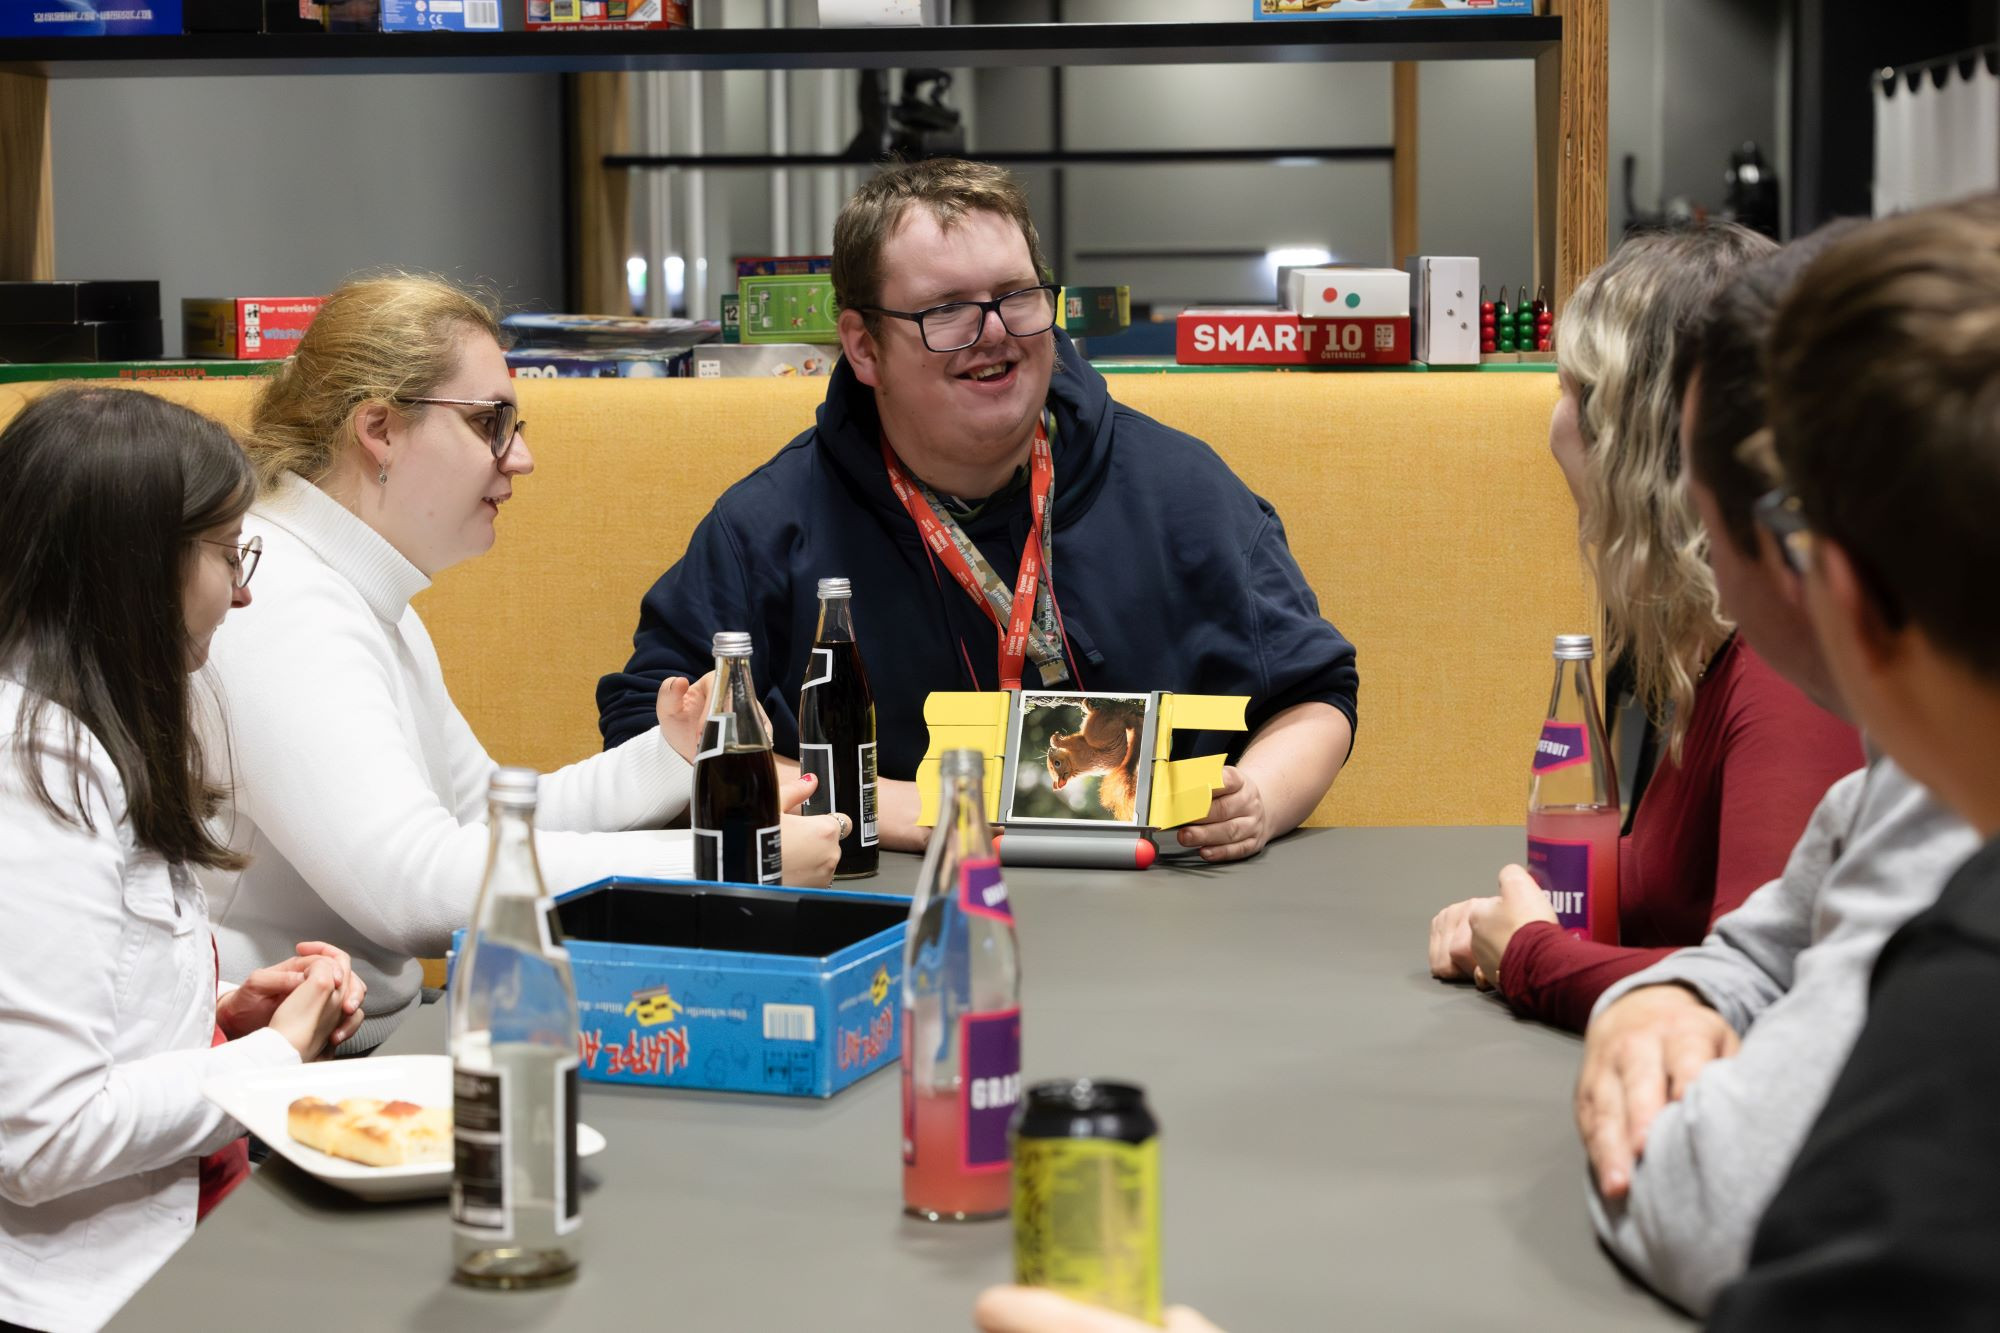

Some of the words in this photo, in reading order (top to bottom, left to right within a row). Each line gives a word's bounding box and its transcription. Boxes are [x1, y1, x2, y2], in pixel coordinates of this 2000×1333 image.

[725, 306, 738, 321] 12
[1194, 324, 1317, 352] SMART
[1325, 324, 1362, 351] 10
[1321, 351, 1366, 359] ÖSTERREICH
[159, 369, 184, 377] NACH
[186, 368, 206, 377] DEM
[1007, 635, 1016, 656] Kronen
[1015, 636, 1024, 656] Zeitung
[604, 1025, 690, 1076] KLAPPE
